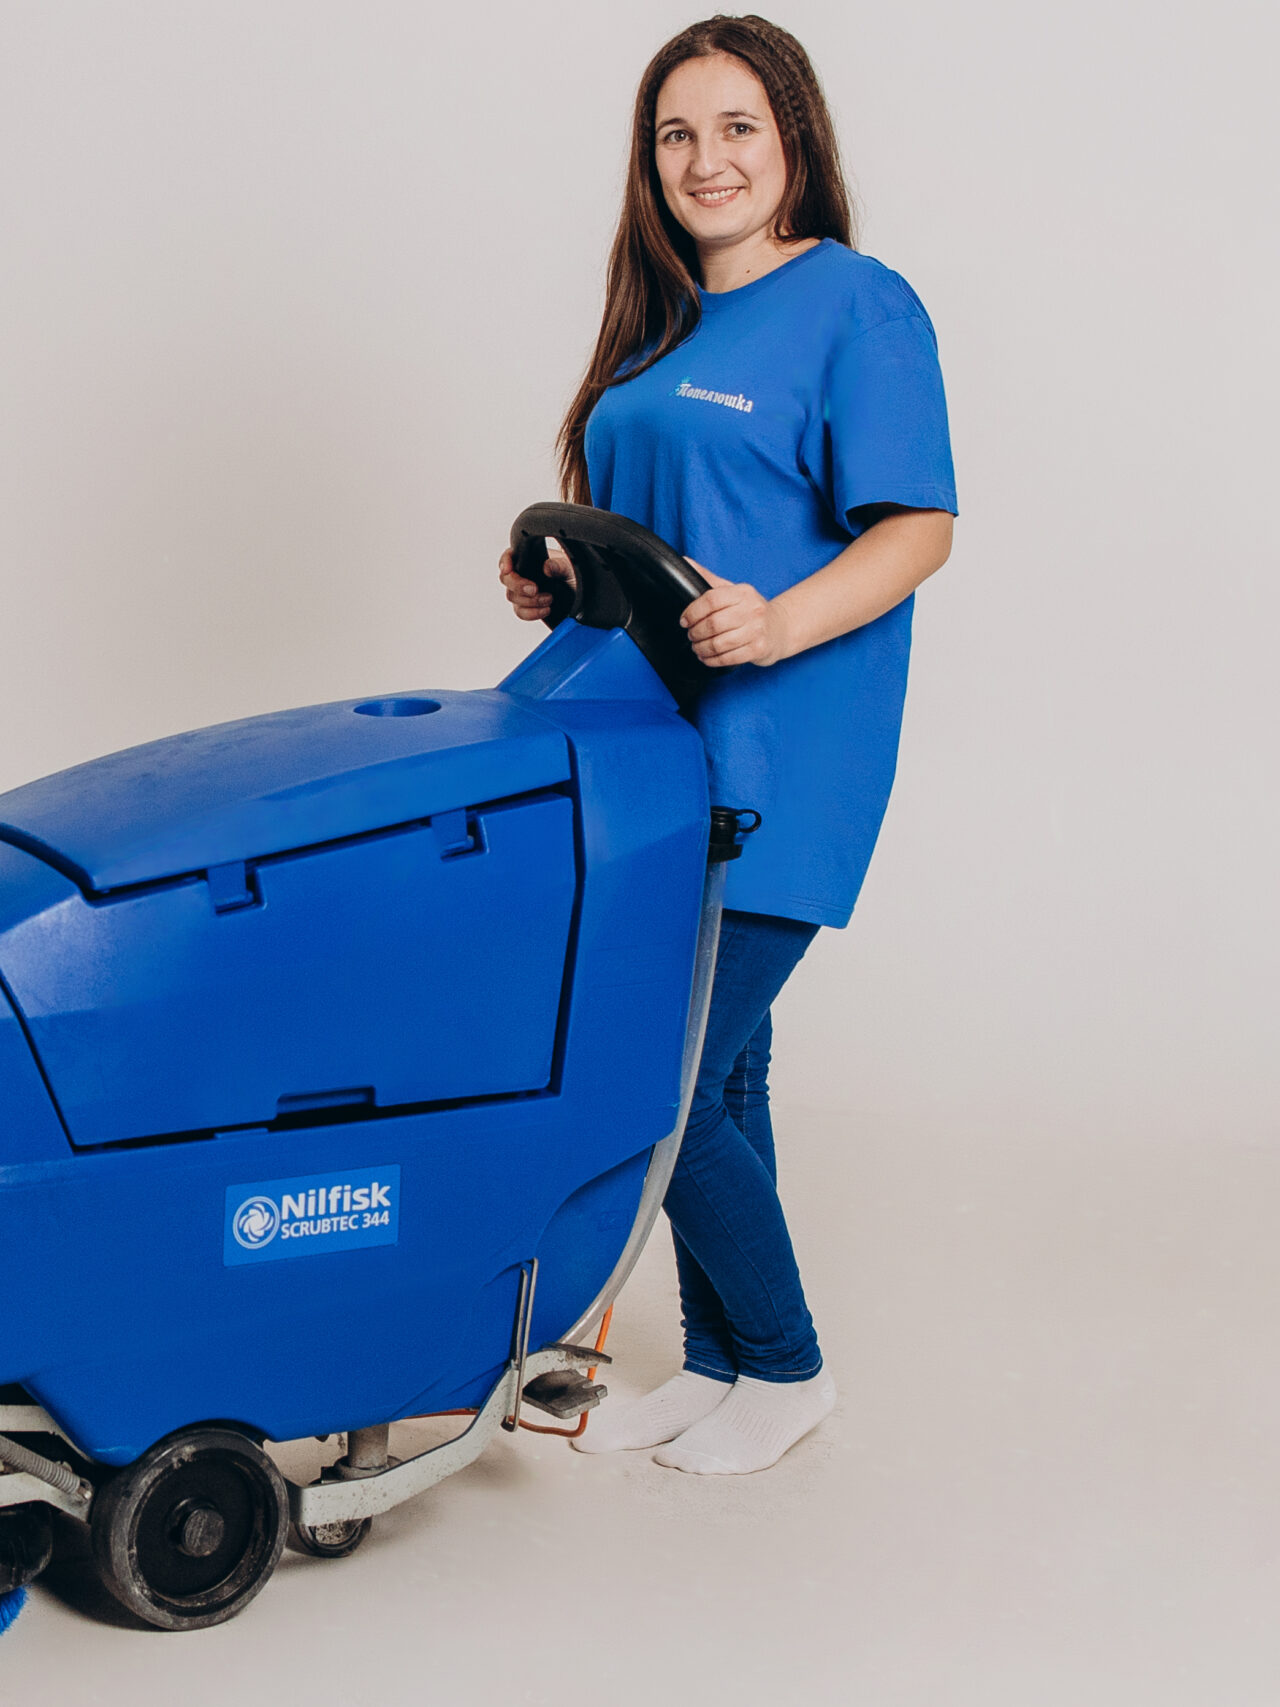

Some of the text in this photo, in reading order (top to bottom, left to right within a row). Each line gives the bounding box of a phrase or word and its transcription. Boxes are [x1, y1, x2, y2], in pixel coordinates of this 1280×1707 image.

[676, 383, 753, 413] Попелюшка
[281, 1182, 391, 1220] Nilfisk
[281, 1210, 389, 1239] SCRUBTEC 344
